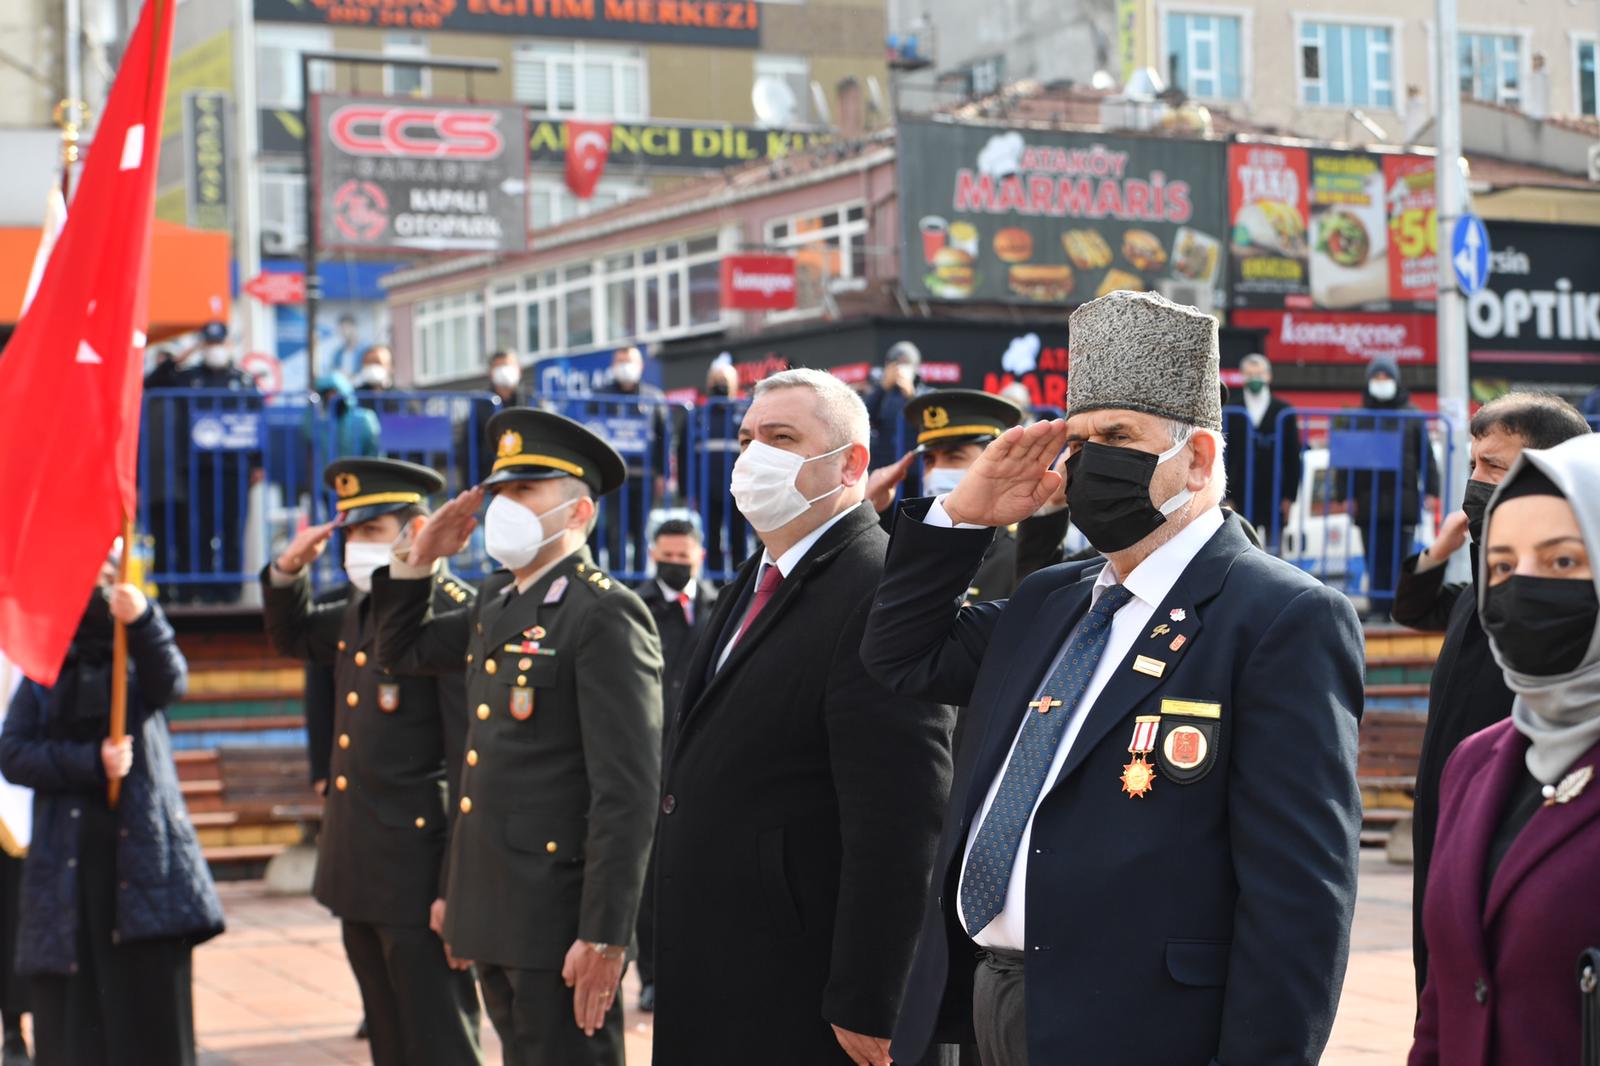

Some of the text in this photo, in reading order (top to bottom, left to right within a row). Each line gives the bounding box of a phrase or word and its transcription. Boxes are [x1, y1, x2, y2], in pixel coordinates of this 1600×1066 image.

[329, 104, 505, 161] CCS
[691, 123, 757, 160] DİL
[1021, 142, 1129, 178] ATAKÖY
[409, 187, 489, 214] KAPALI
[953, 168, 1192, 224] MARMARİS
[394, 213, 502, 237] OTOPARK
[1468, 277, 1600, 341] OPTİK
